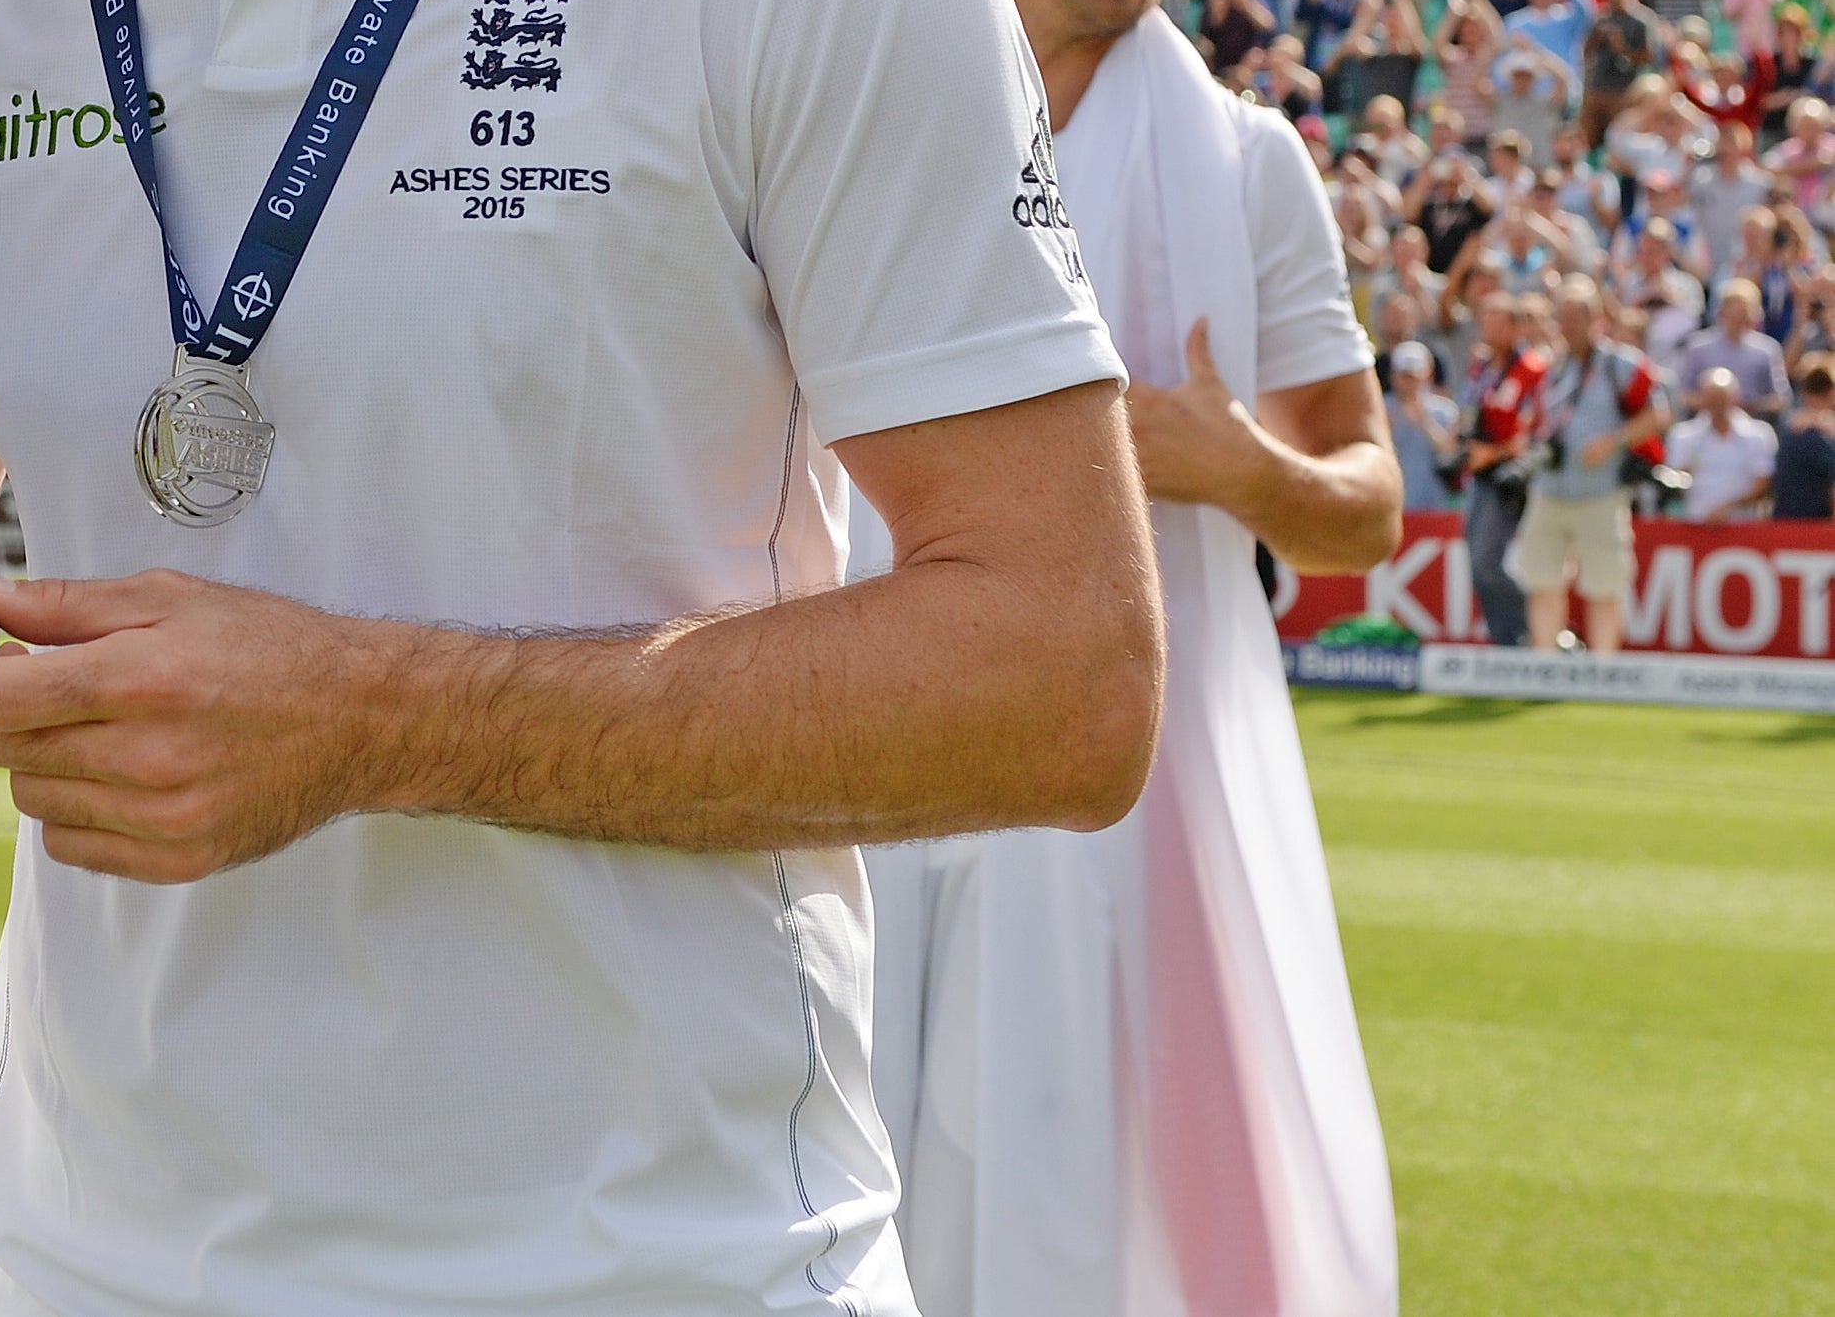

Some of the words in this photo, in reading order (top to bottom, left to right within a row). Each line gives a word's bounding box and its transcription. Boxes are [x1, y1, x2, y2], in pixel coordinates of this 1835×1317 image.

[115, 25, 144, 142] Private
[470, 109, 535, 147] 613
[267, 76, 358, 223] Banking
[390, 167, 490, 194] ASHES
[500, 166, 611, 194] SERIES
[463, 196, 525, 219] 2015
